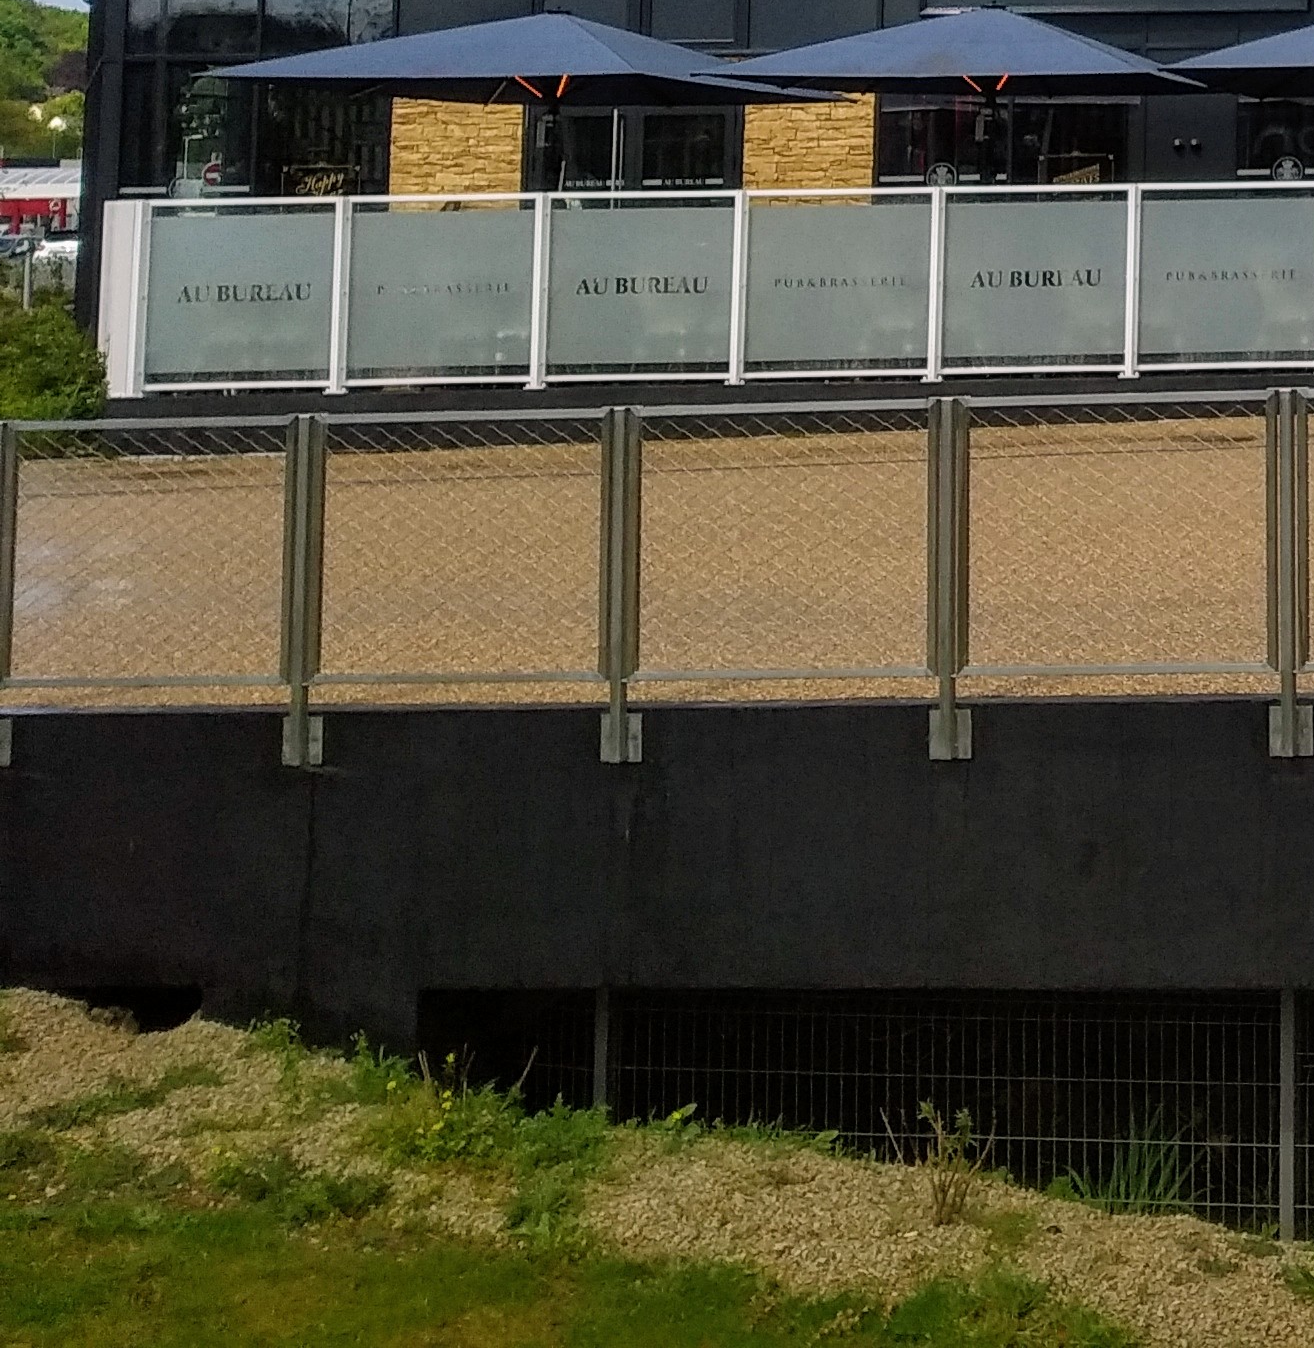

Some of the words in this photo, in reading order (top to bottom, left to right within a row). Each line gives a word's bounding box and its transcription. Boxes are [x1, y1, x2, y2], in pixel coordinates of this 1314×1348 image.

[576, 277, 609, 295] AU
[615, 276, 709, 295] BUREAU
[970, 270, 1002, 288] AU
[178, 285, 210, 303] AU
[217, 282, 312, 303] BUREAU
